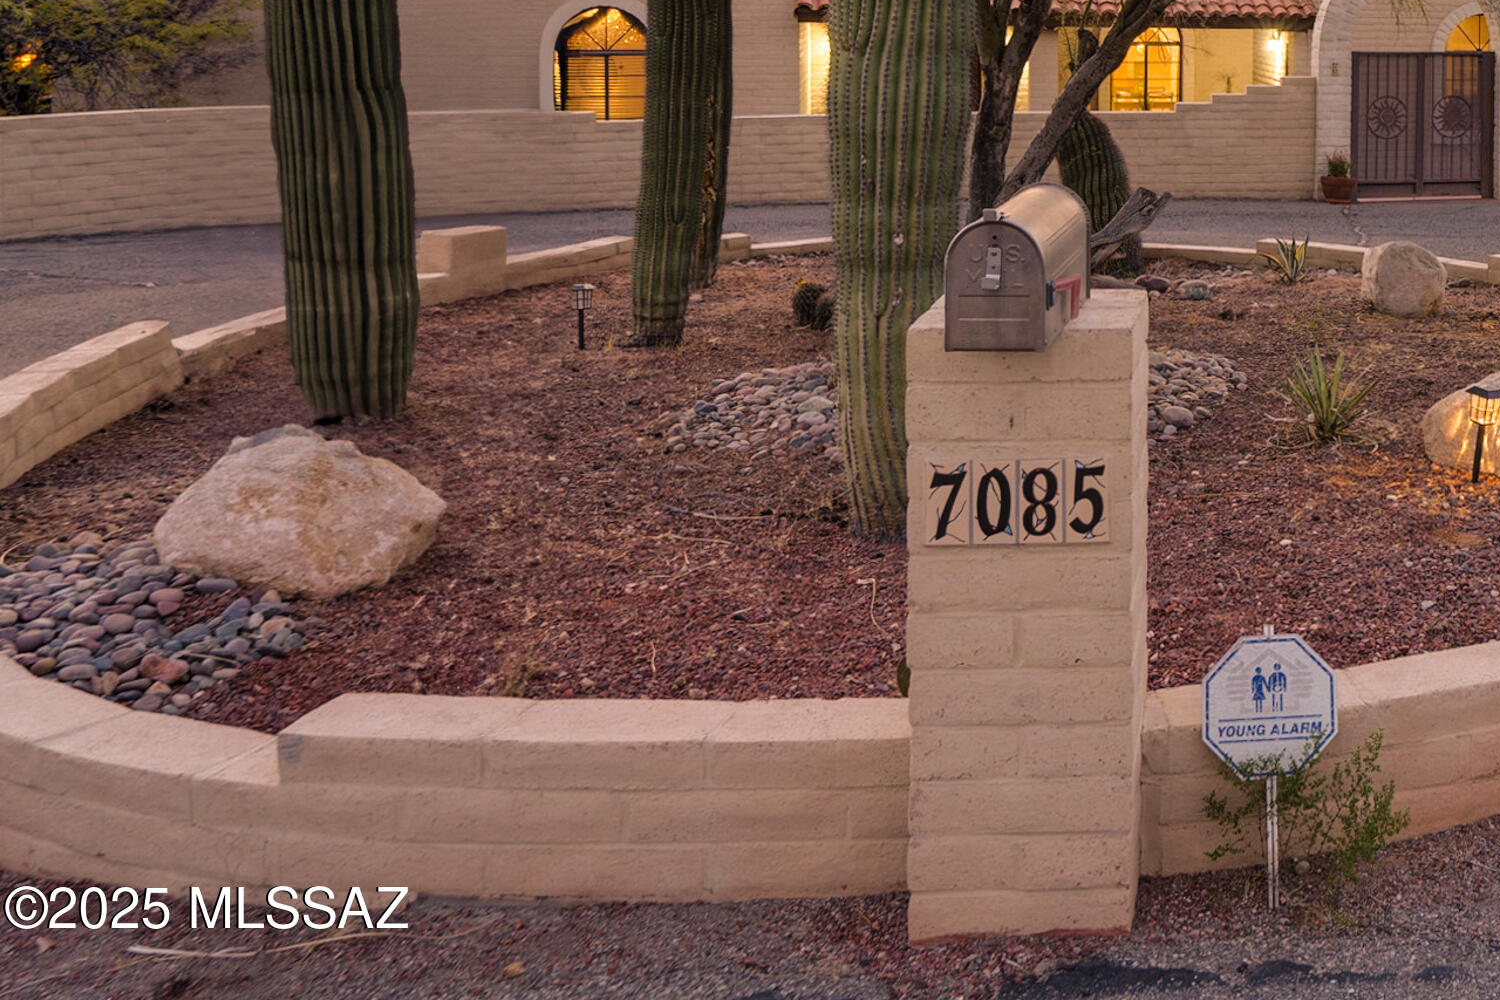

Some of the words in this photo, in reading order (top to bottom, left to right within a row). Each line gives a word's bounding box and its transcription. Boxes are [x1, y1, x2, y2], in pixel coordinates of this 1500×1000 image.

[967, 243, 1026, 263] US.
[962, 268, 1025, 289] ML
[929, 464, 1105, 541] 7085
[1218, 724, 1266, 738] YOUNG
[1270, 721, 1323, 736] ALARM
